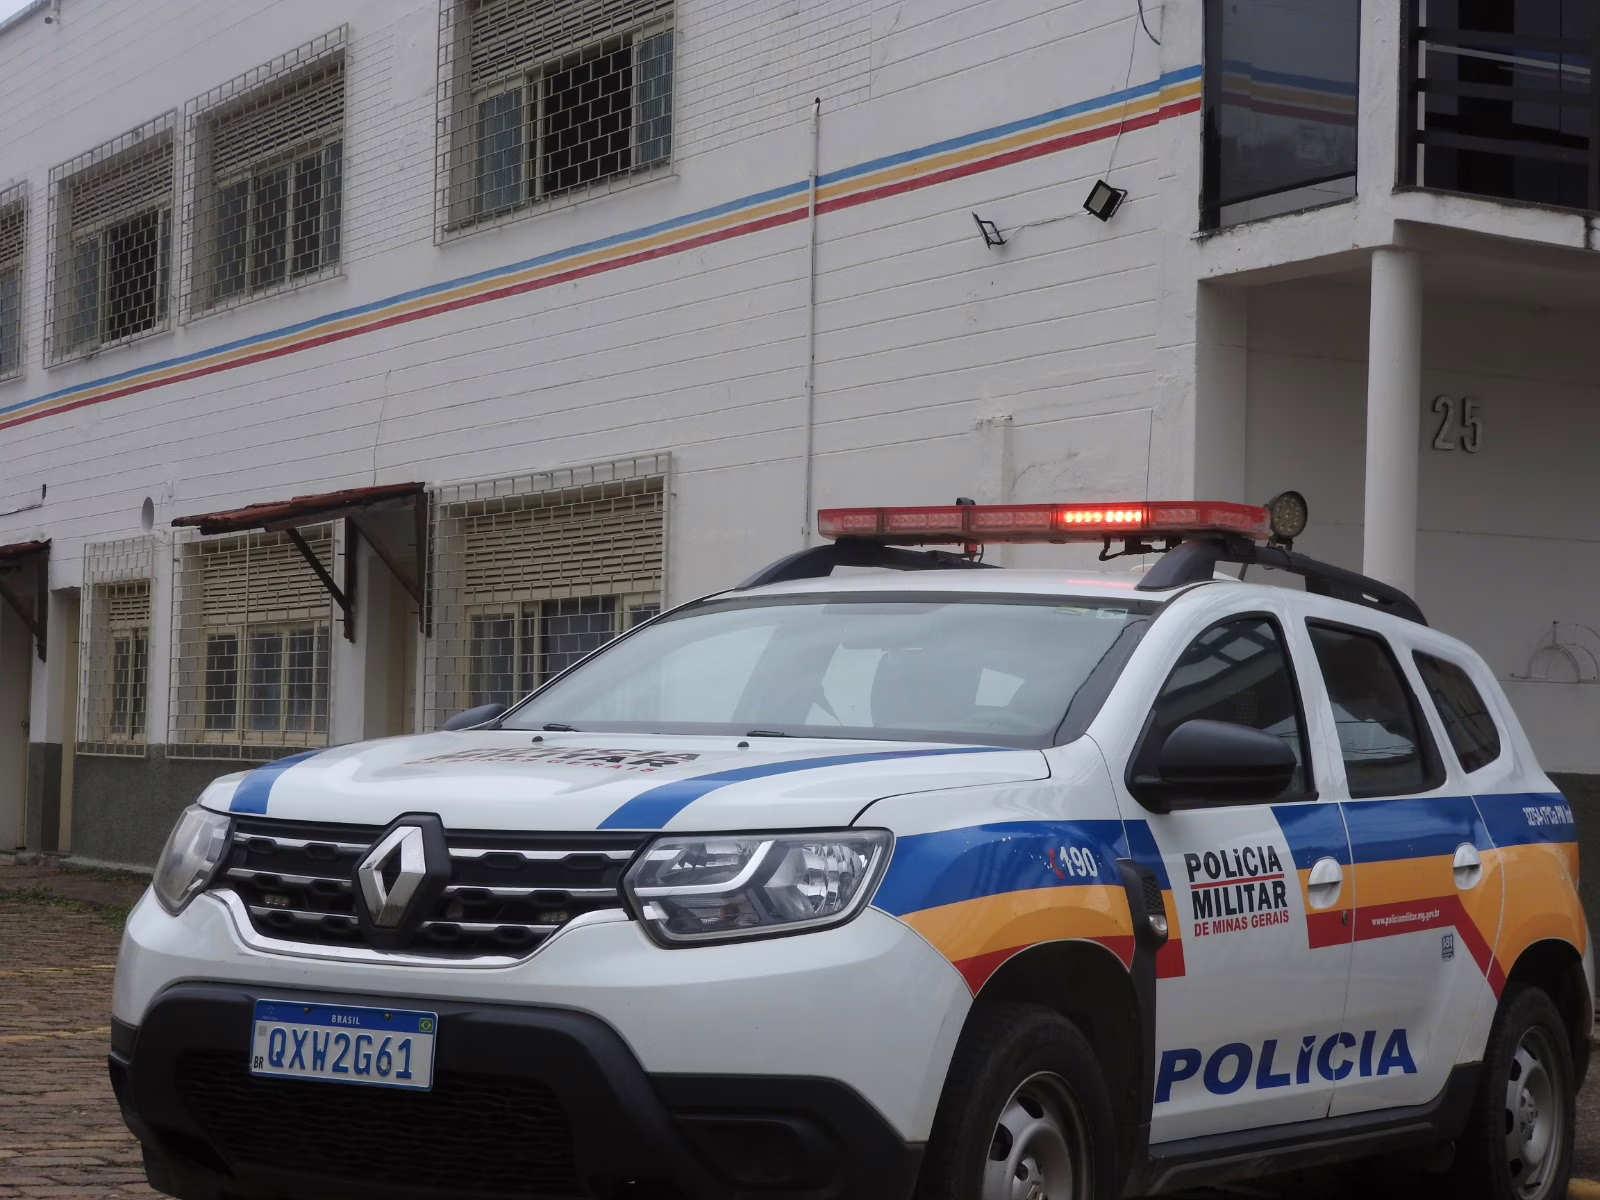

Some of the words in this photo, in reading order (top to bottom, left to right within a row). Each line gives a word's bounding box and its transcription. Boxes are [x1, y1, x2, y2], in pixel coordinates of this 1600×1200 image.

[1432, 395, 1482, 453] 25
[545, 759, 658, 773] GERAIS
[1060, 846, 1098, 877] 190
[1184, 845, 1283, 882] POLÍCIA
[1191, 880, 1288, 920] MILITAR
[1194, 922, 1209, 937] DE
[1213, 916, 1248, 934] MINAS
[1251, 910, 1289, 928] GERAIS
[331, 1014, 360, 1025] BRASIL
[253, 1055, 264, 1069] BR
[268, 1027, 412, 1079] QXW2G61
[1154, 1028, 1417, 1103] POLÍCIA
